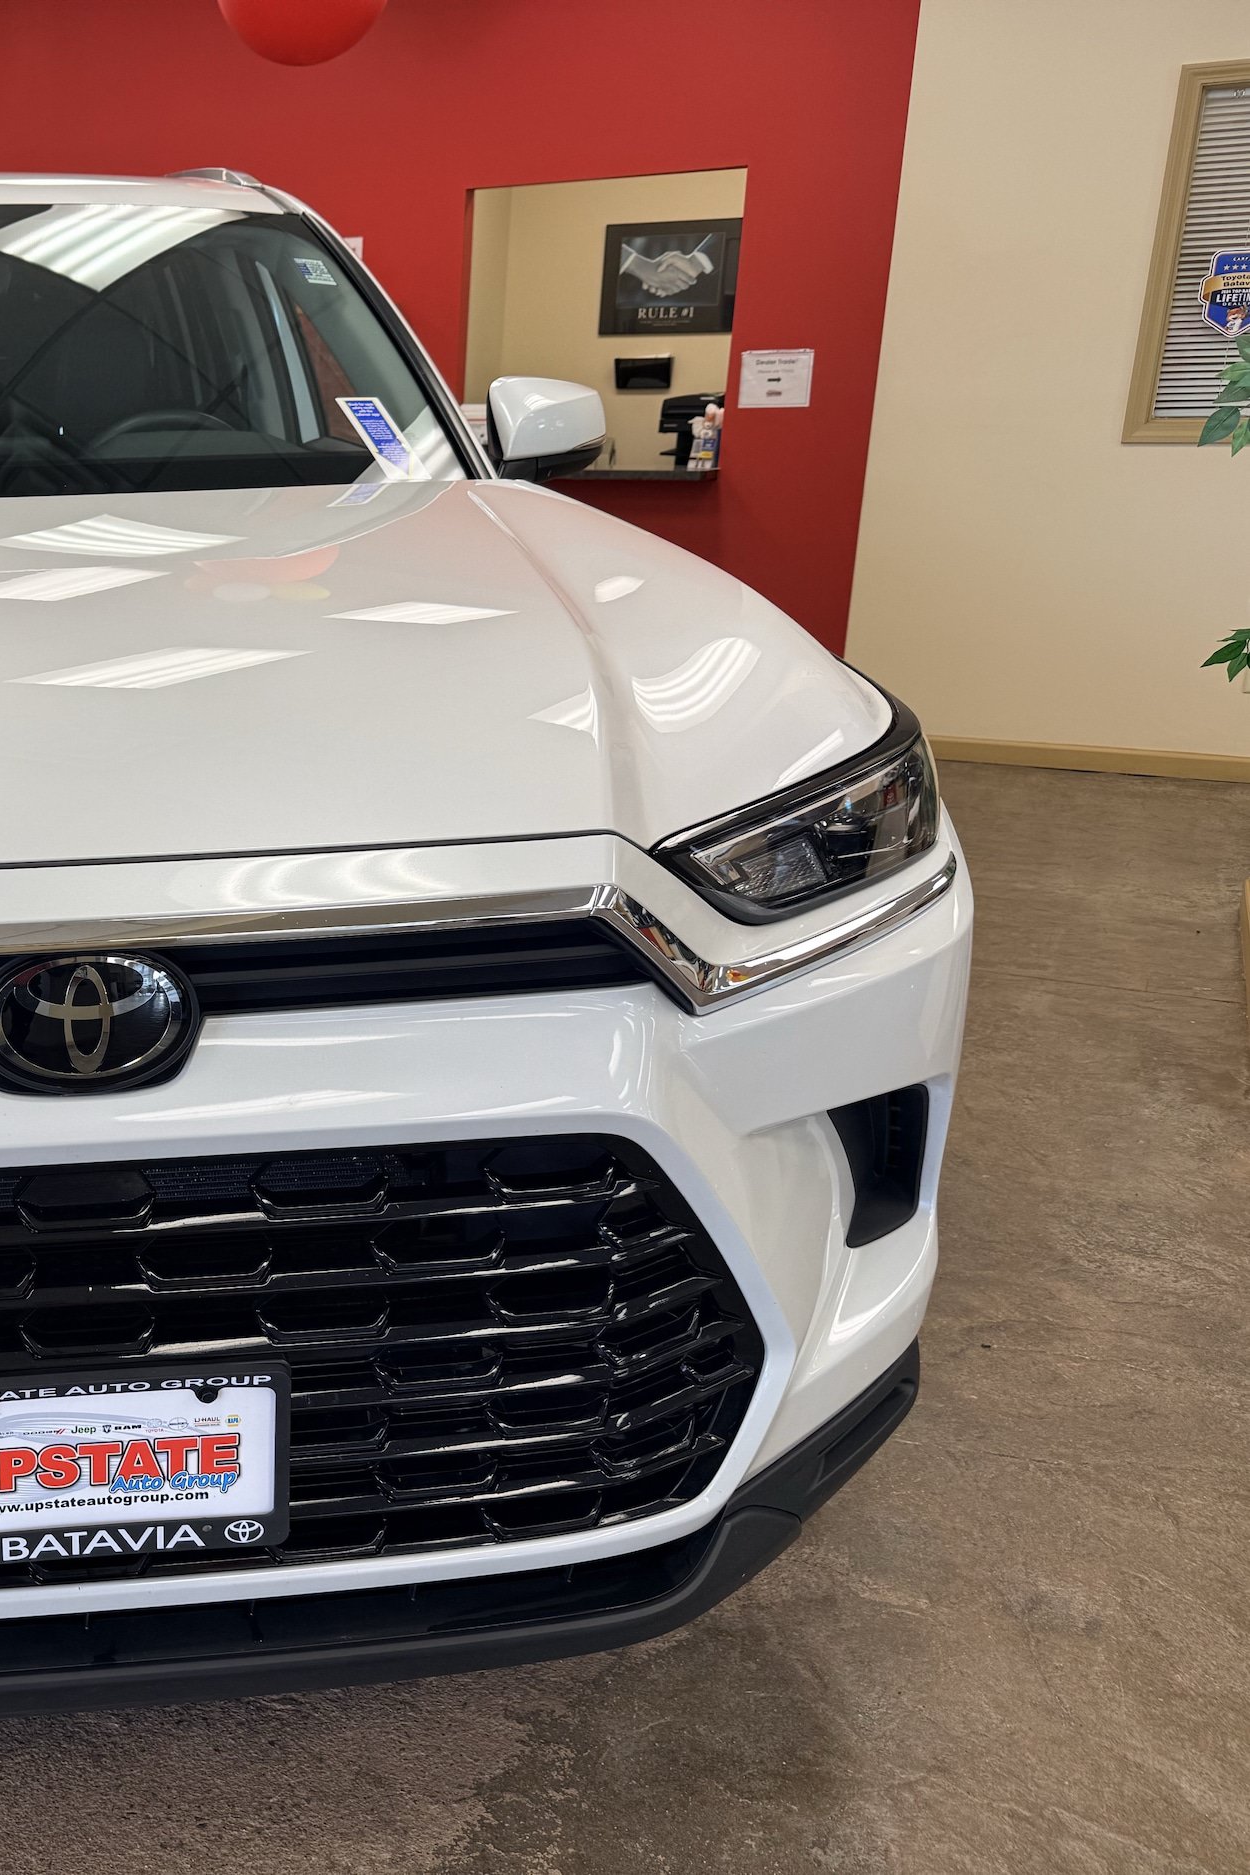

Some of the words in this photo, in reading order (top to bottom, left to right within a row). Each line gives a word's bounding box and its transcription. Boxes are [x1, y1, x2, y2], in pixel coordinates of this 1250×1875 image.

[638, 307, 677, 319] RULE
[65, 1382, 151, 1396] AUTO
[160, 1375, 272, 1389] GROUP
[71, 1425, 96, 1435] Jeep
[110, 1474, 164, 1493] Auto
[170, 1470, 238, 1494] Group
[2, 1524, 206, 1561] BATAVIA
